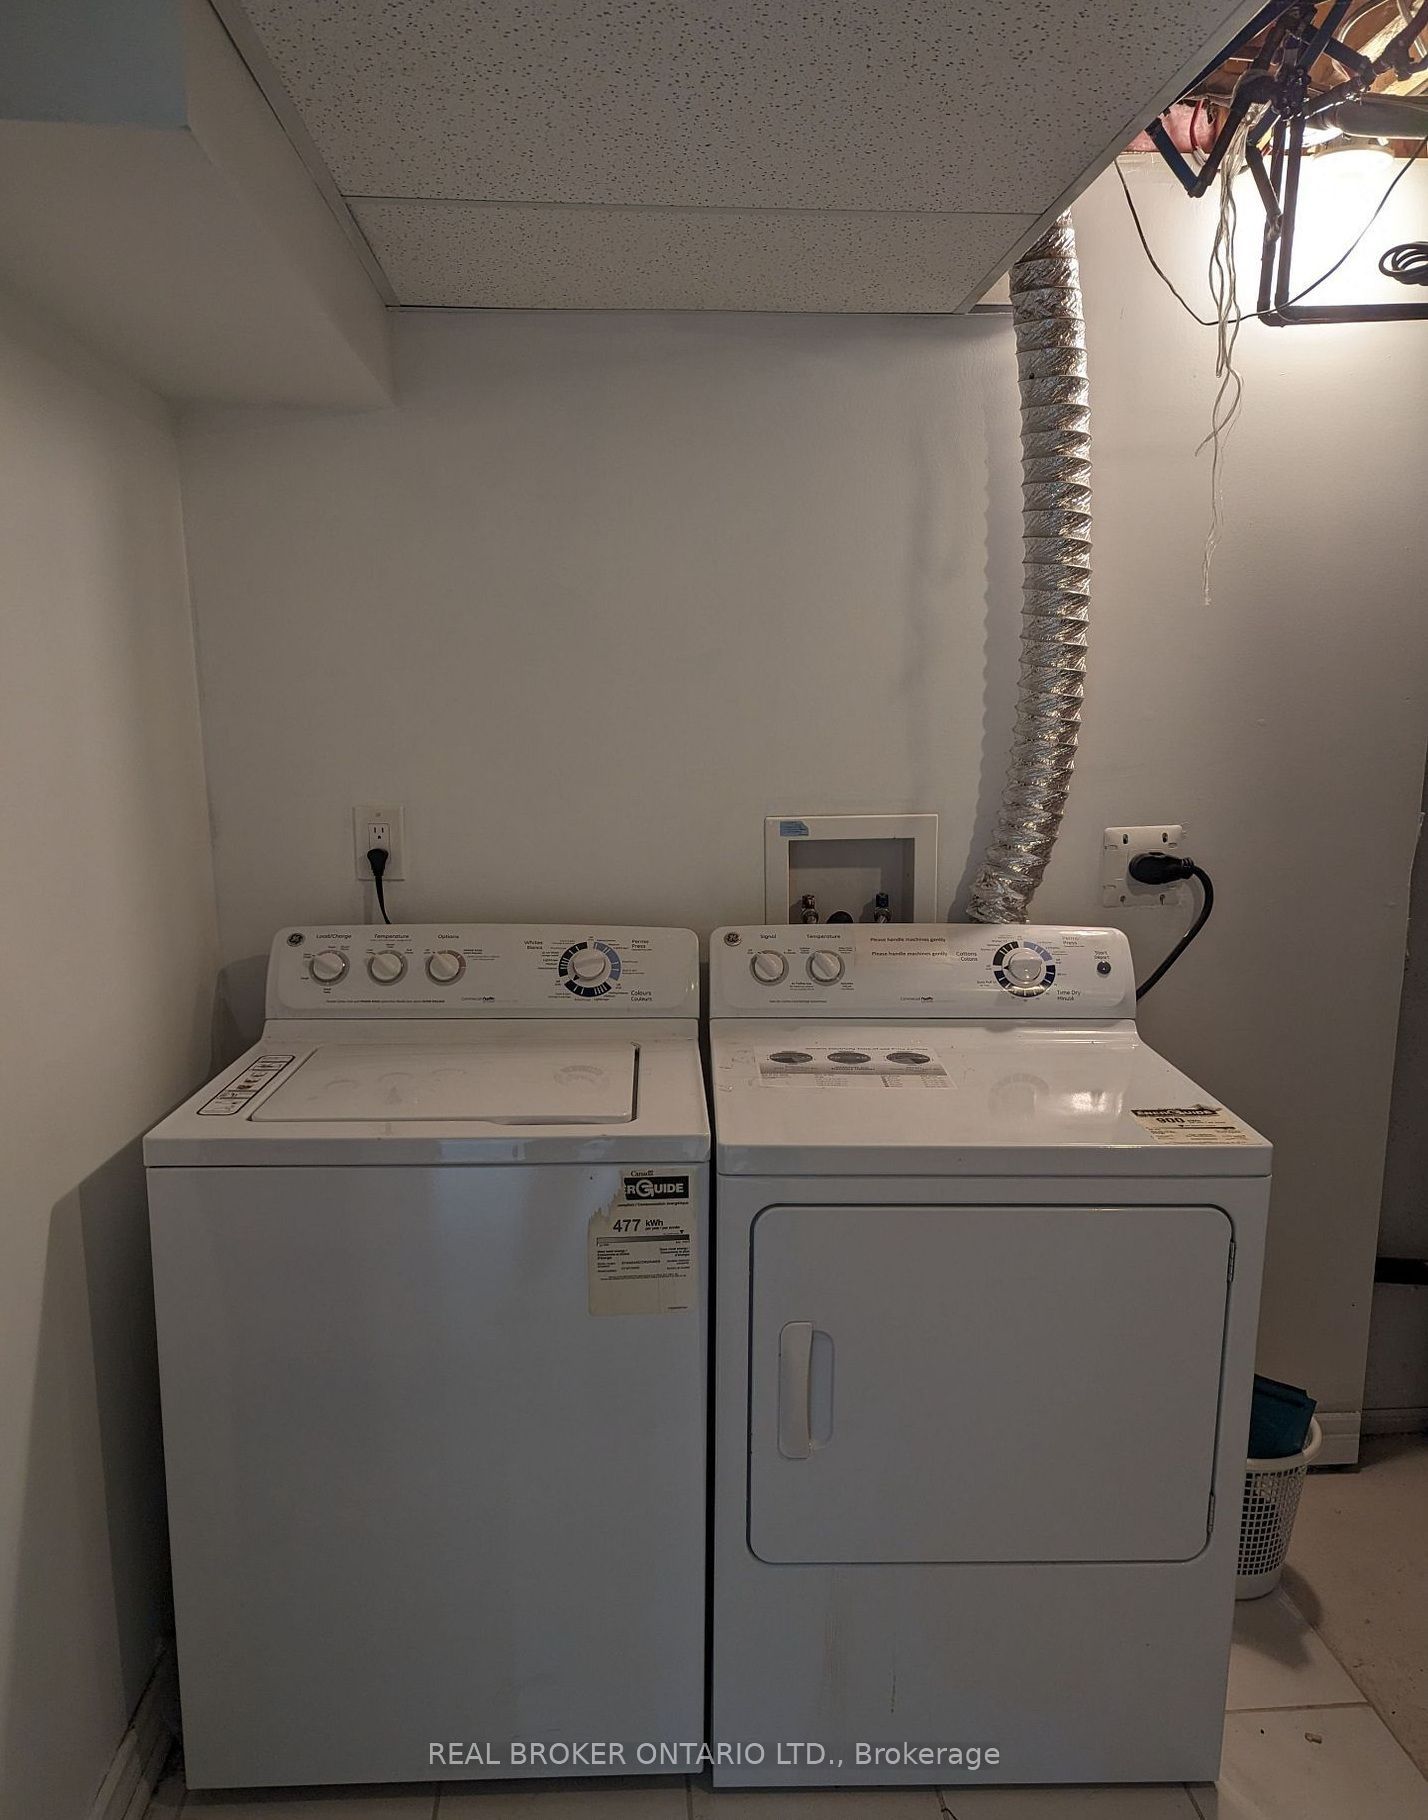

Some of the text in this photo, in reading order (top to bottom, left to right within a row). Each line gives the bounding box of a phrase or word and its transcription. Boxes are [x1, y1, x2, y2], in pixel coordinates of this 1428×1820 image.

[760, 933, 777, 941] Signal
[624, 1179, 685, 1198] RGUIDE
[612, 1218, 664, 1233] 477 kWh
